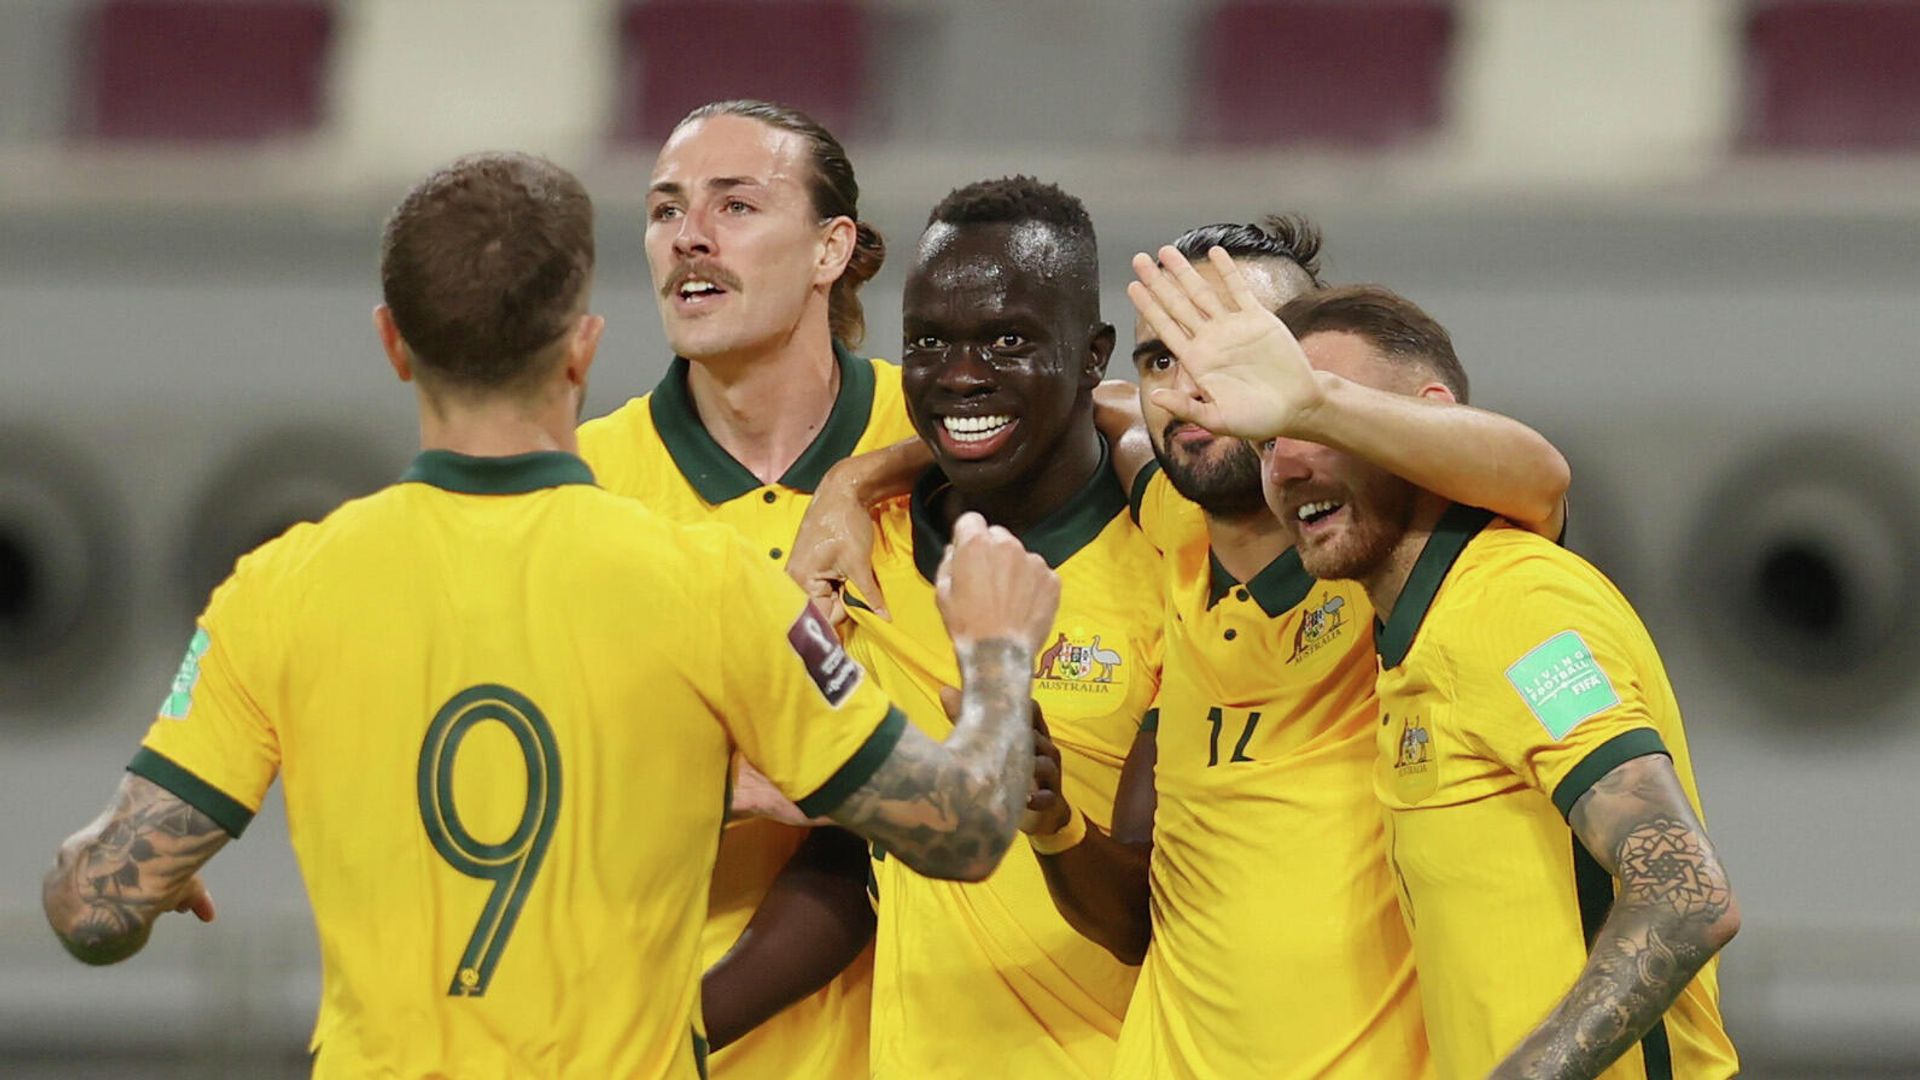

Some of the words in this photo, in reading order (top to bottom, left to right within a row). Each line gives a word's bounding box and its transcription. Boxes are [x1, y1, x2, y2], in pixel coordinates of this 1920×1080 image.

[1038, 681, 1109, 693] AUSTRALIA
[1525, 650, 1585, 694] LIVING
[1530, 660, 1589, 702] FOOTBALL
[1571, 675, 1601, 695] FIFA
[417, 683, 563, 997] 9
